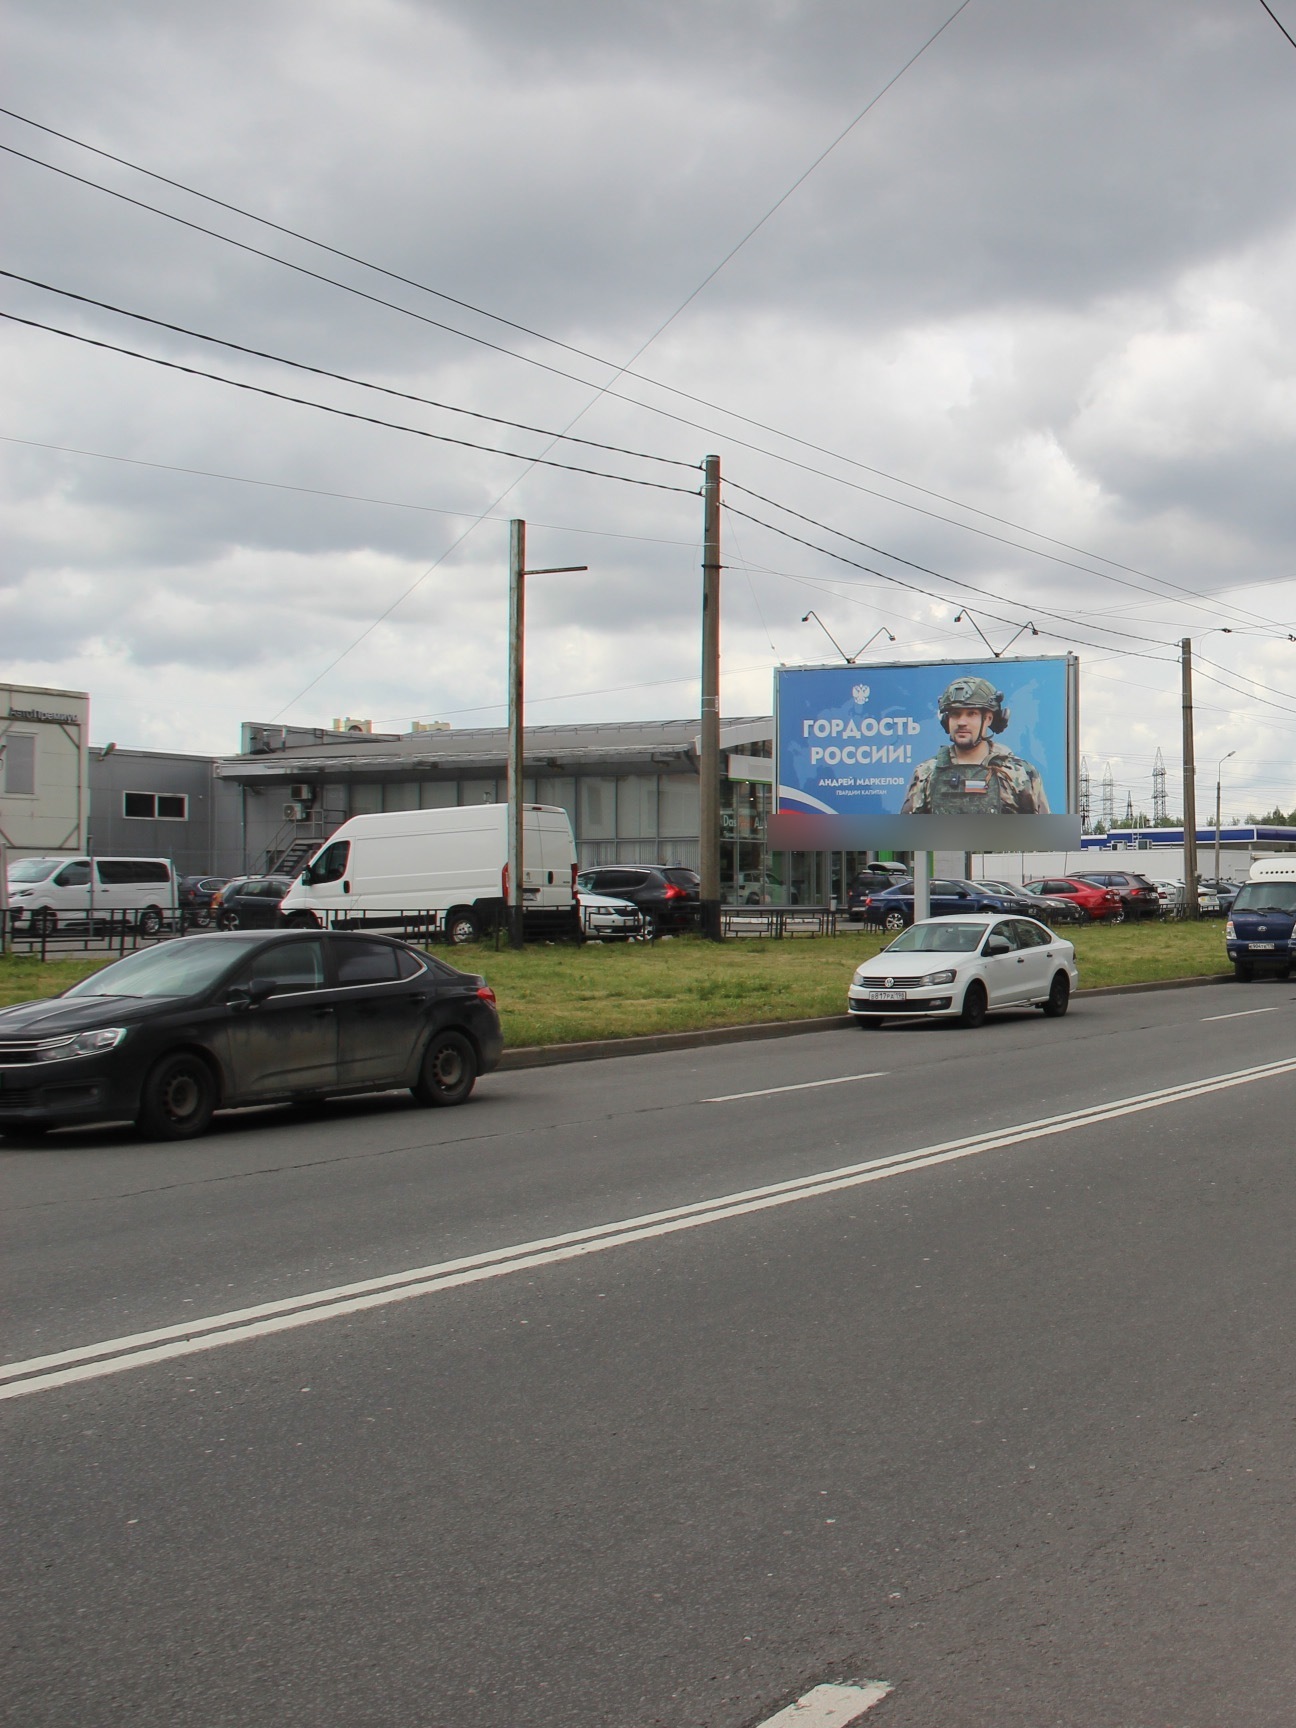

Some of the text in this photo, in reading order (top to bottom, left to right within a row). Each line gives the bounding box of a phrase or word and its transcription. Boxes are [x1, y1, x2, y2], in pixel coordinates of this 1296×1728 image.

[803, 717, 920, 739] ГОРДОСТЬ
[811, 745, 912, 765] РОССИИ!
[818, 777, 905, 786] АНДРЕЙ МАРКЕЛОВ
